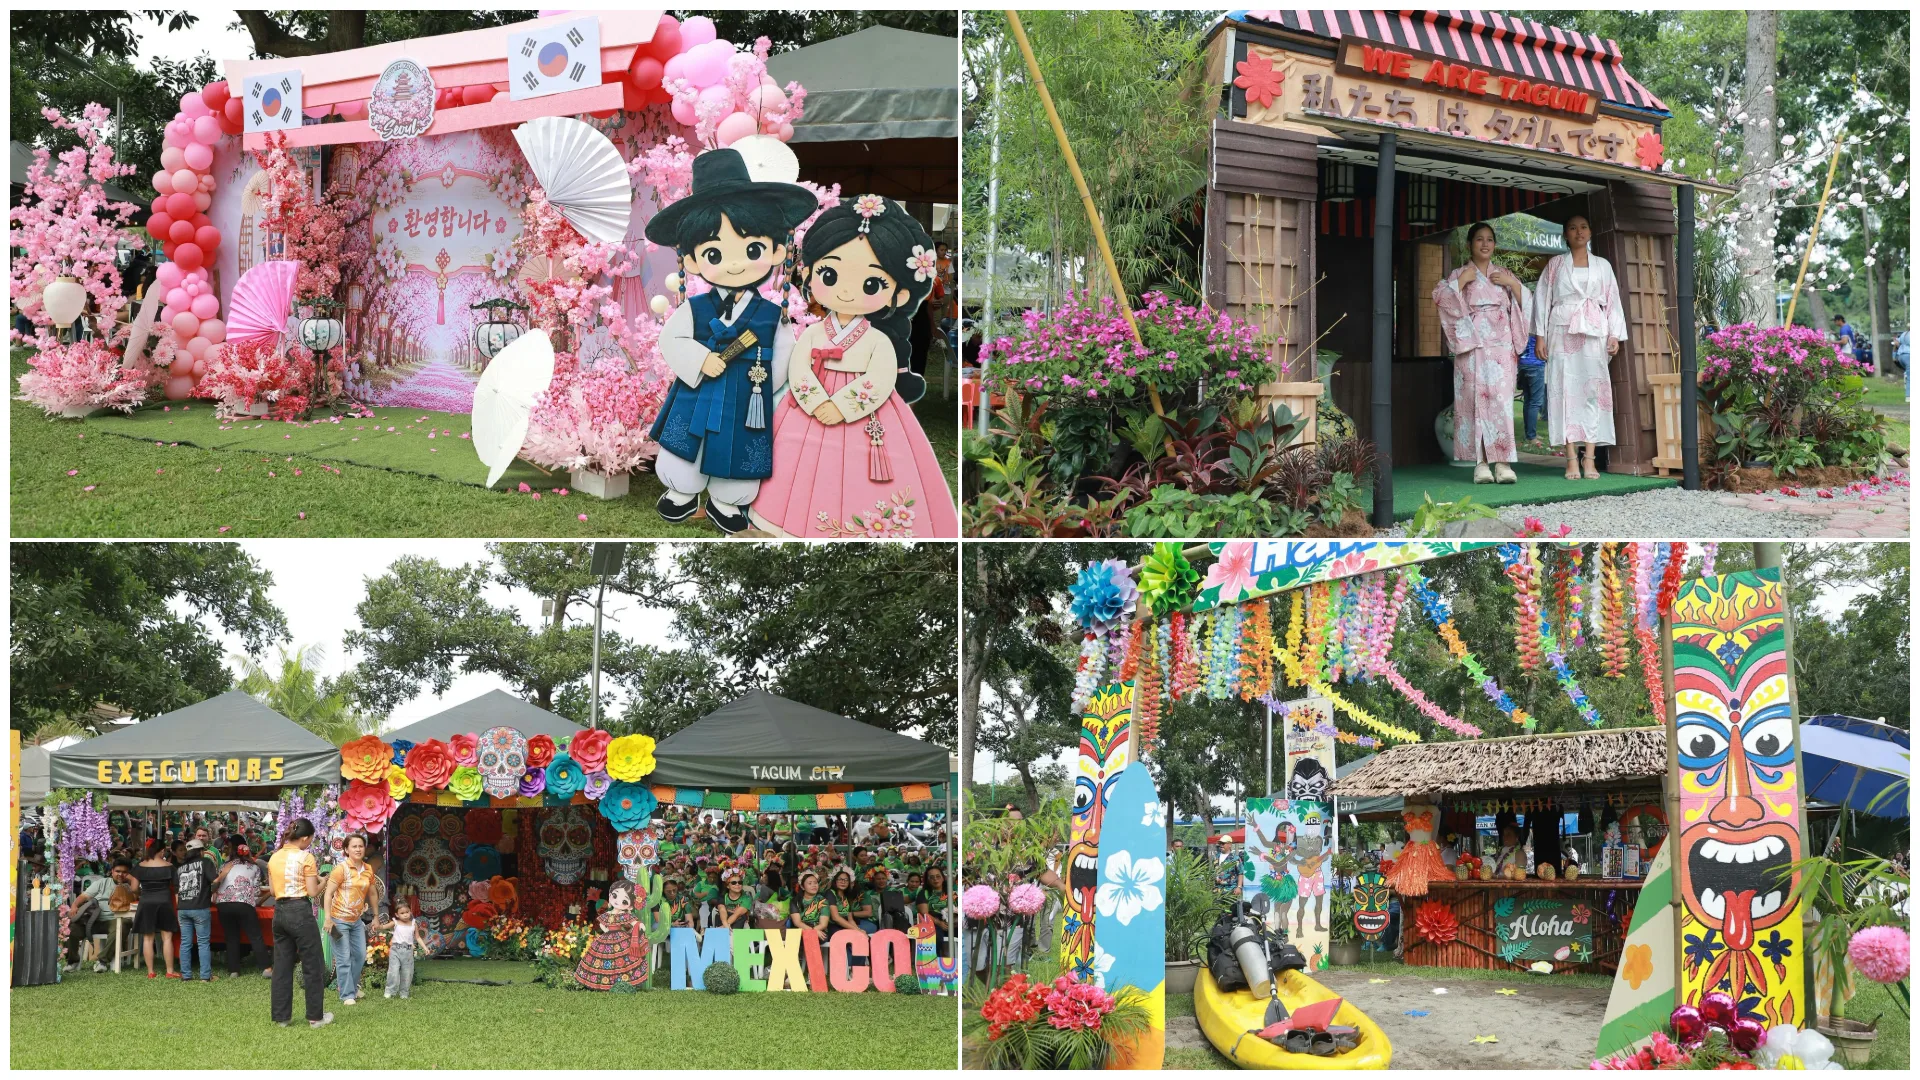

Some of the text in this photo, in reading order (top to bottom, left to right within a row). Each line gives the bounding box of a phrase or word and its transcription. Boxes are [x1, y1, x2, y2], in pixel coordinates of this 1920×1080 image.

[1361, 44, 1589, 114] WE ARE TAGUM
[1301, 73, 1417, 125] 私たち
[1436, 99, 1471, 136] は
[382, 116, 418, 139] Seoul
[404, 206, 491, 238] 환영합니다
[1525, 231, 1562, 249] TAGUM
[98, 757, 284, 782] EXECUTORS
[751, 765, 802, 780] TAGUM
[1340, 800, 1358, 811] CITY
[1509, 914, 1575, 941] Aloha
[670, 927, 913, 993] MEXICO
